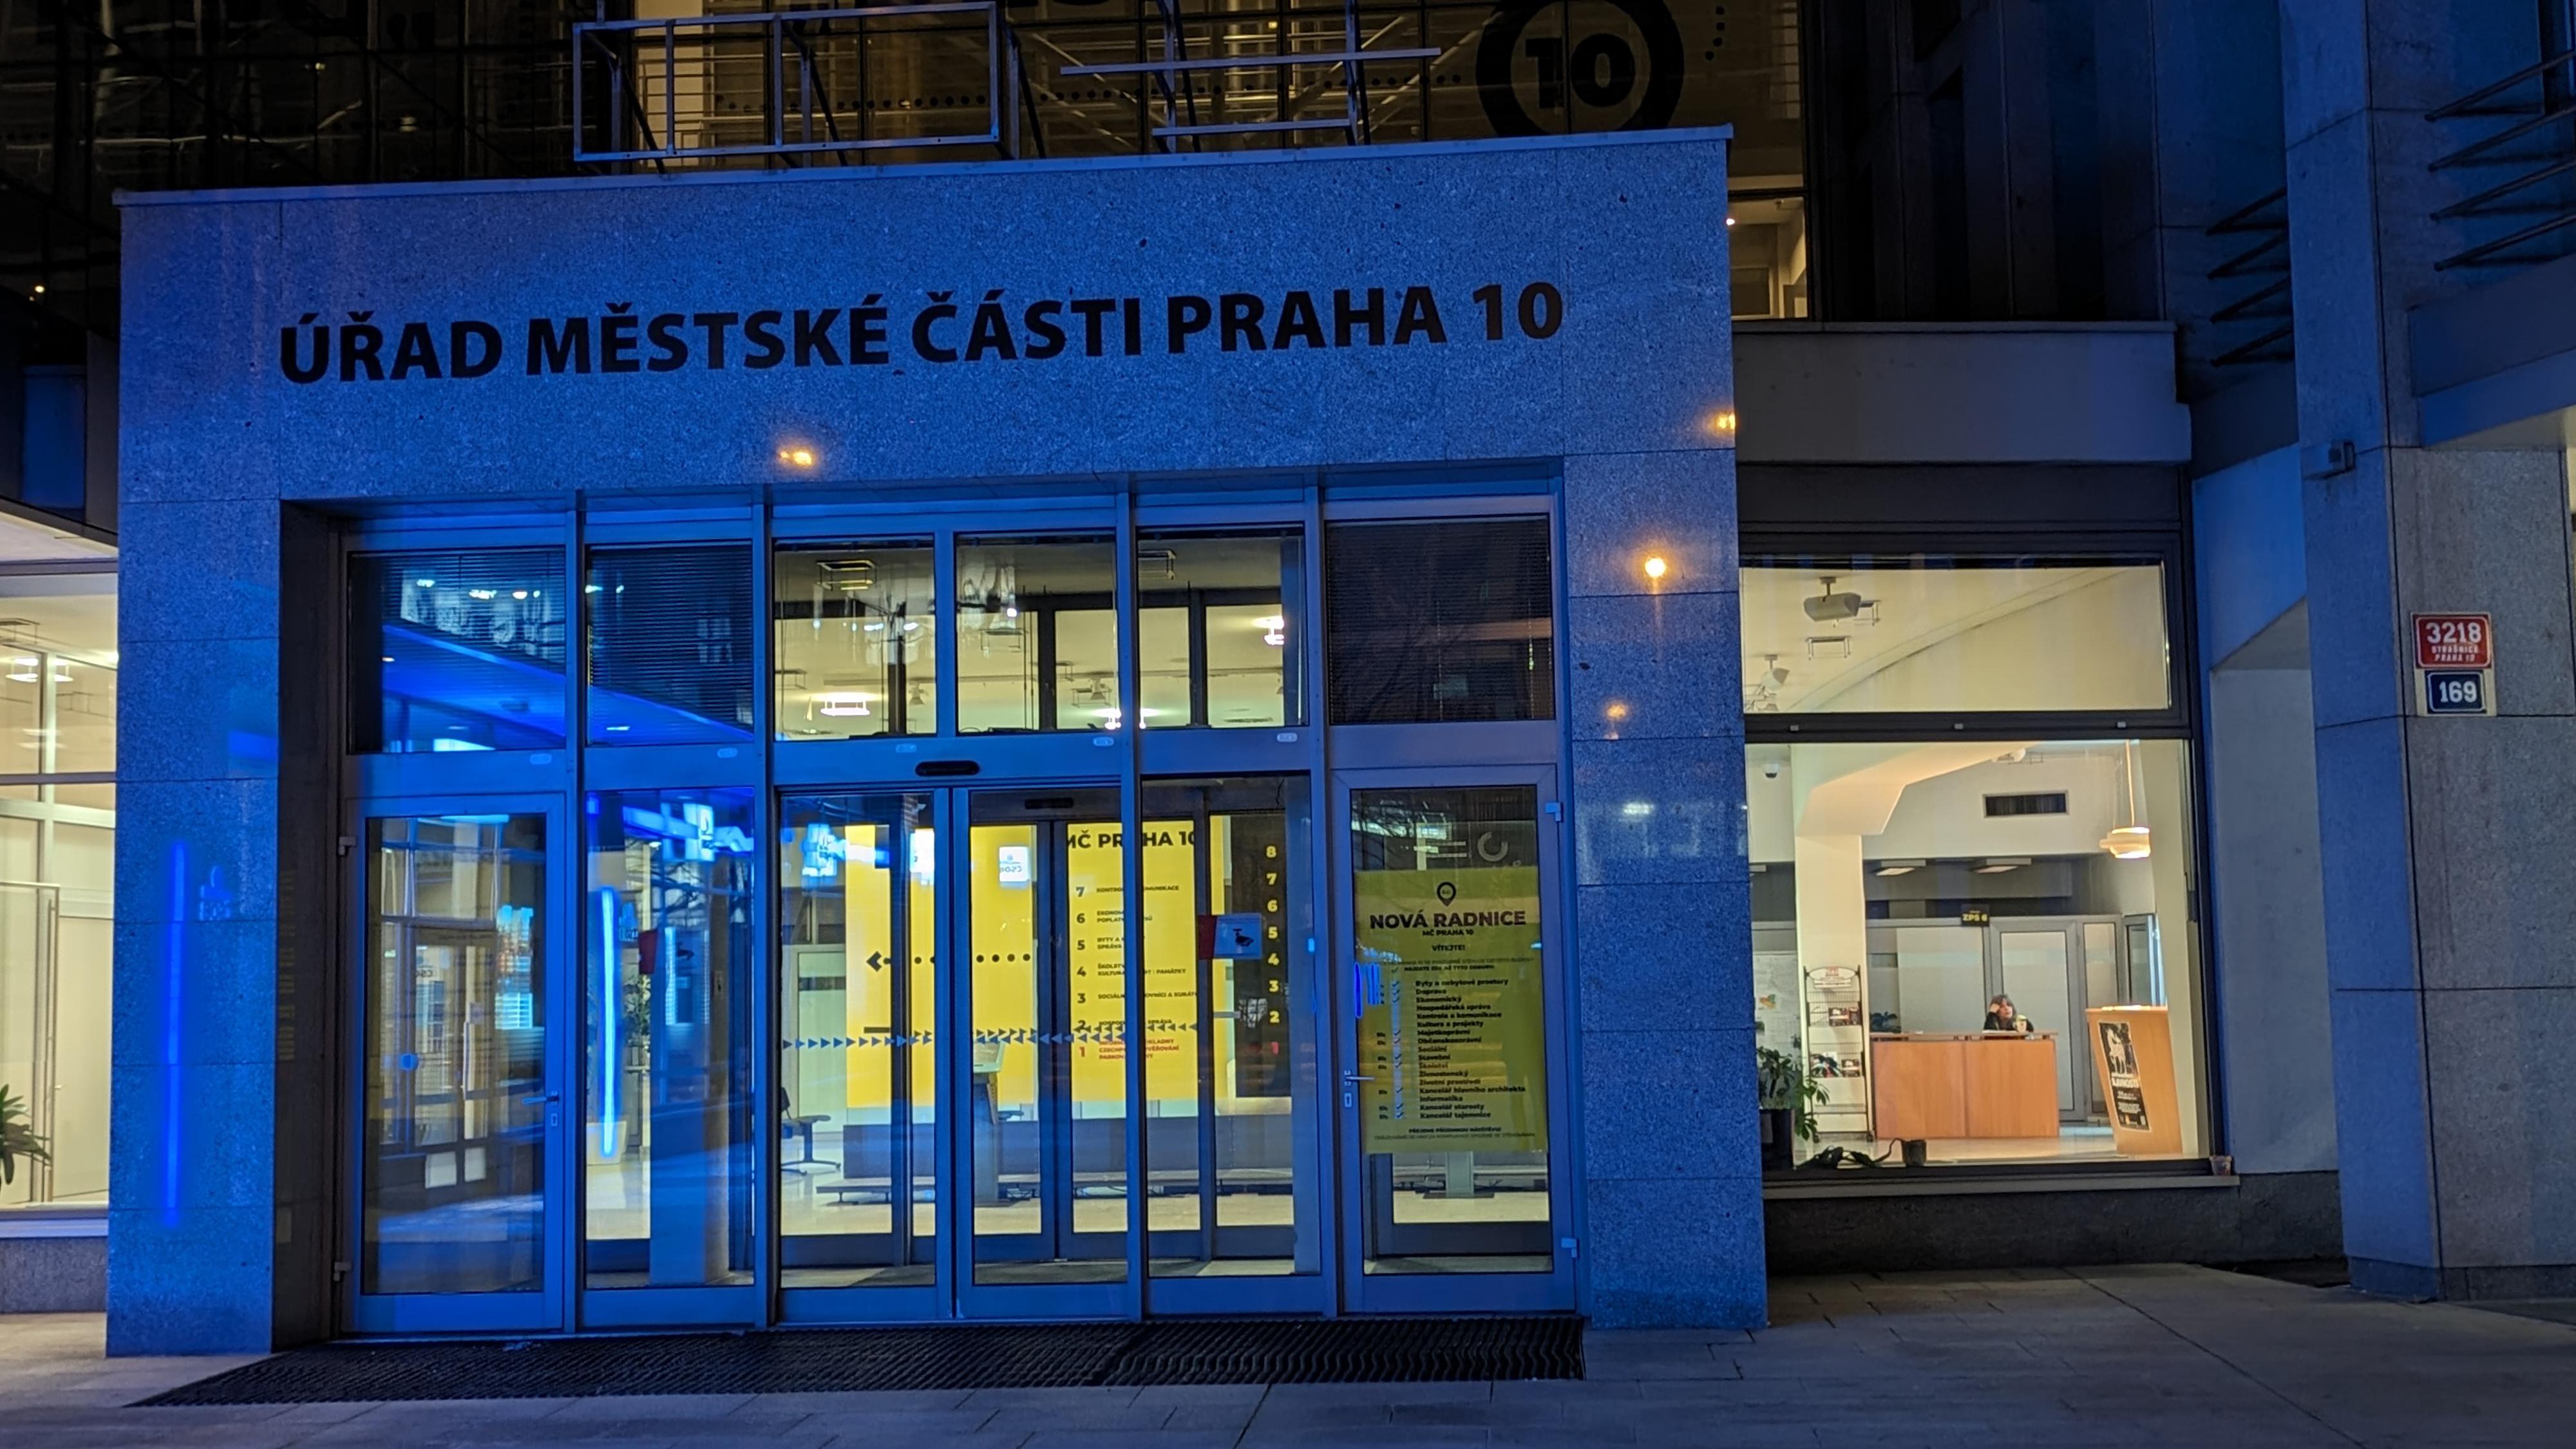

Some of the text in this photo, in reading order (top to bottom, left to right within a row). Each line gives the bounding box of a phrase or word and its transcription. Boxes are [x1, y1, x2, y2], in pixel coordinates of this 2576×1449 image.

[1526, 33, 1636, 108] 10
[280, 282, 1563, 384] ÚŘAD MĚSTSKÉ ČÁSTI PRAHA 10
[2425, 622, 2481, 643] 3218
[2439, 681, 2477, 703] 169
[1266, 846, 1276, 858] 8
[1266, 873, 1277, 885] 7
[1075, 887, 1085, 898] 7
[1267, 900, 1278, 913] 6
[1077, 913, 1085, 923] 6
[1370, 909, 1526, 929] NOVÁ RADNICE
[1268, 926, 1278, 939] 5
[1077, 940, 1086, 950] 5
[1267, 953, 1280, 965] 4
[1077, 967, 1086, 977] 4
[1269, 980, 1279, 992] 3
[1077, 993, 1086, 1003] 3
[1270, 1010, 1280, 1023] 2
[1077, 1020, 1086, 1029] 2
[1079, 1046, 1085, 1057] 1
[1271, 1041, 1279, 1055] 1
